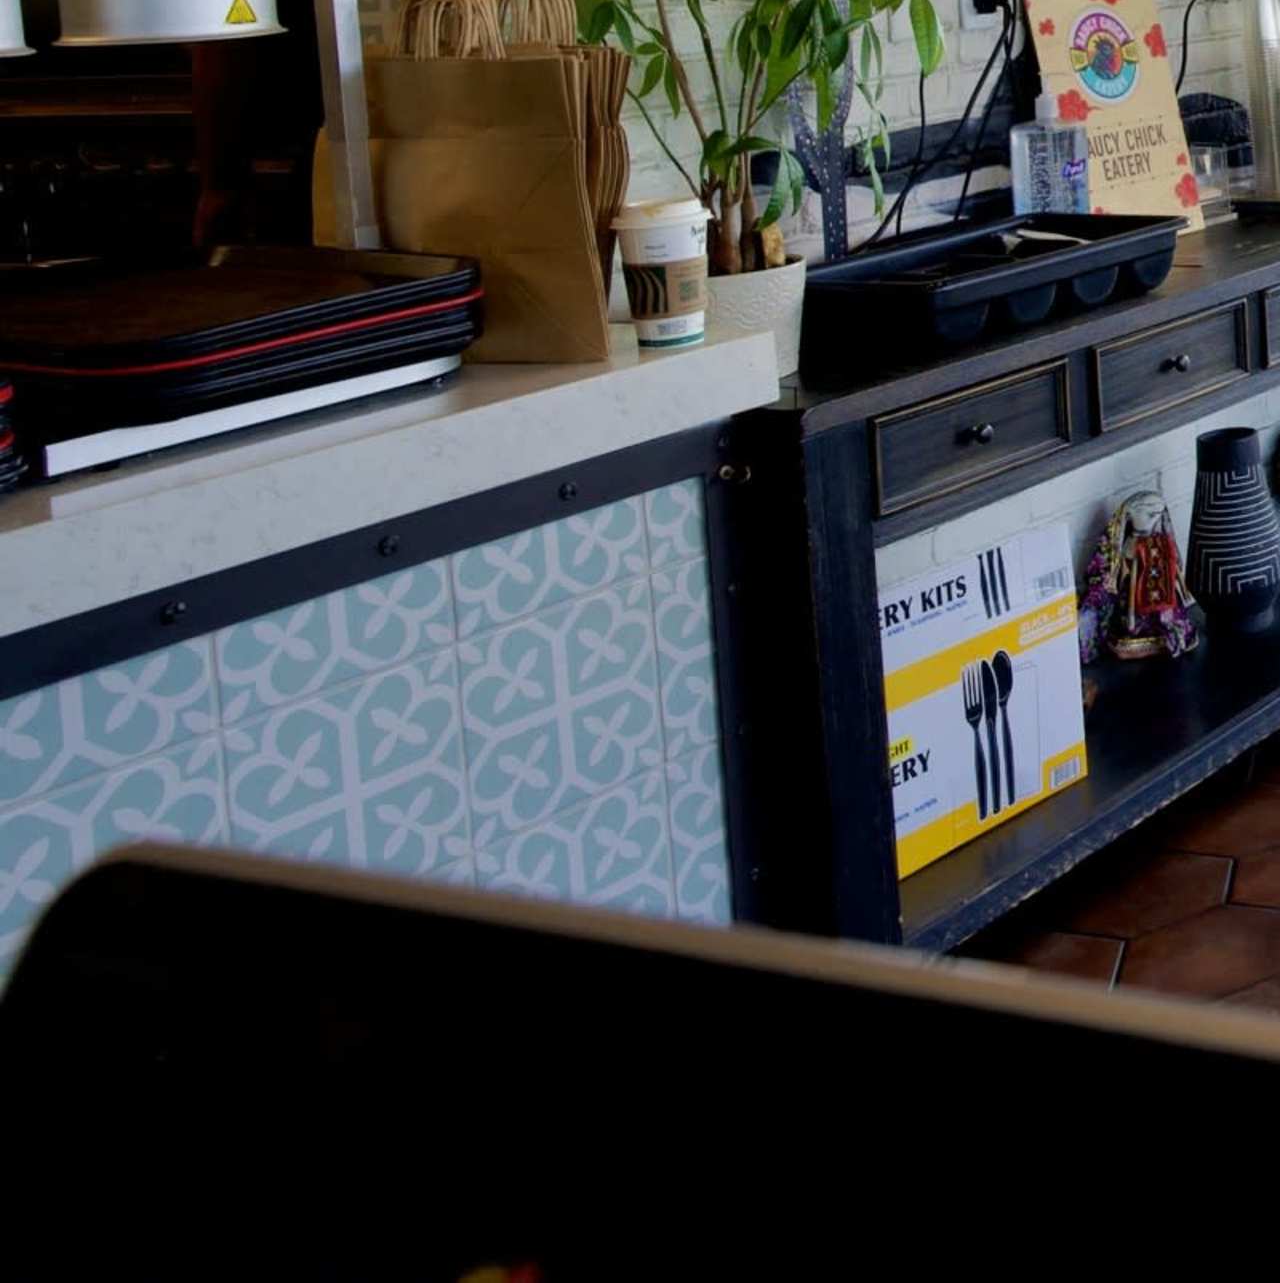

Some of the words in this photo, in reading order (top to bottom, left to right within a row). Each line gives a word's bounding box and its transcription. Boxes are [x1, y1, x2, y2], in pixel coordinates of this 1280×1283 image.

[1087, 132, 1121, 160] AUCY
[1124, 123, 1167, 153] CHICK
[1101, 151, 1152, 182] EATERY
[920, 575, 967, 613] KITS
